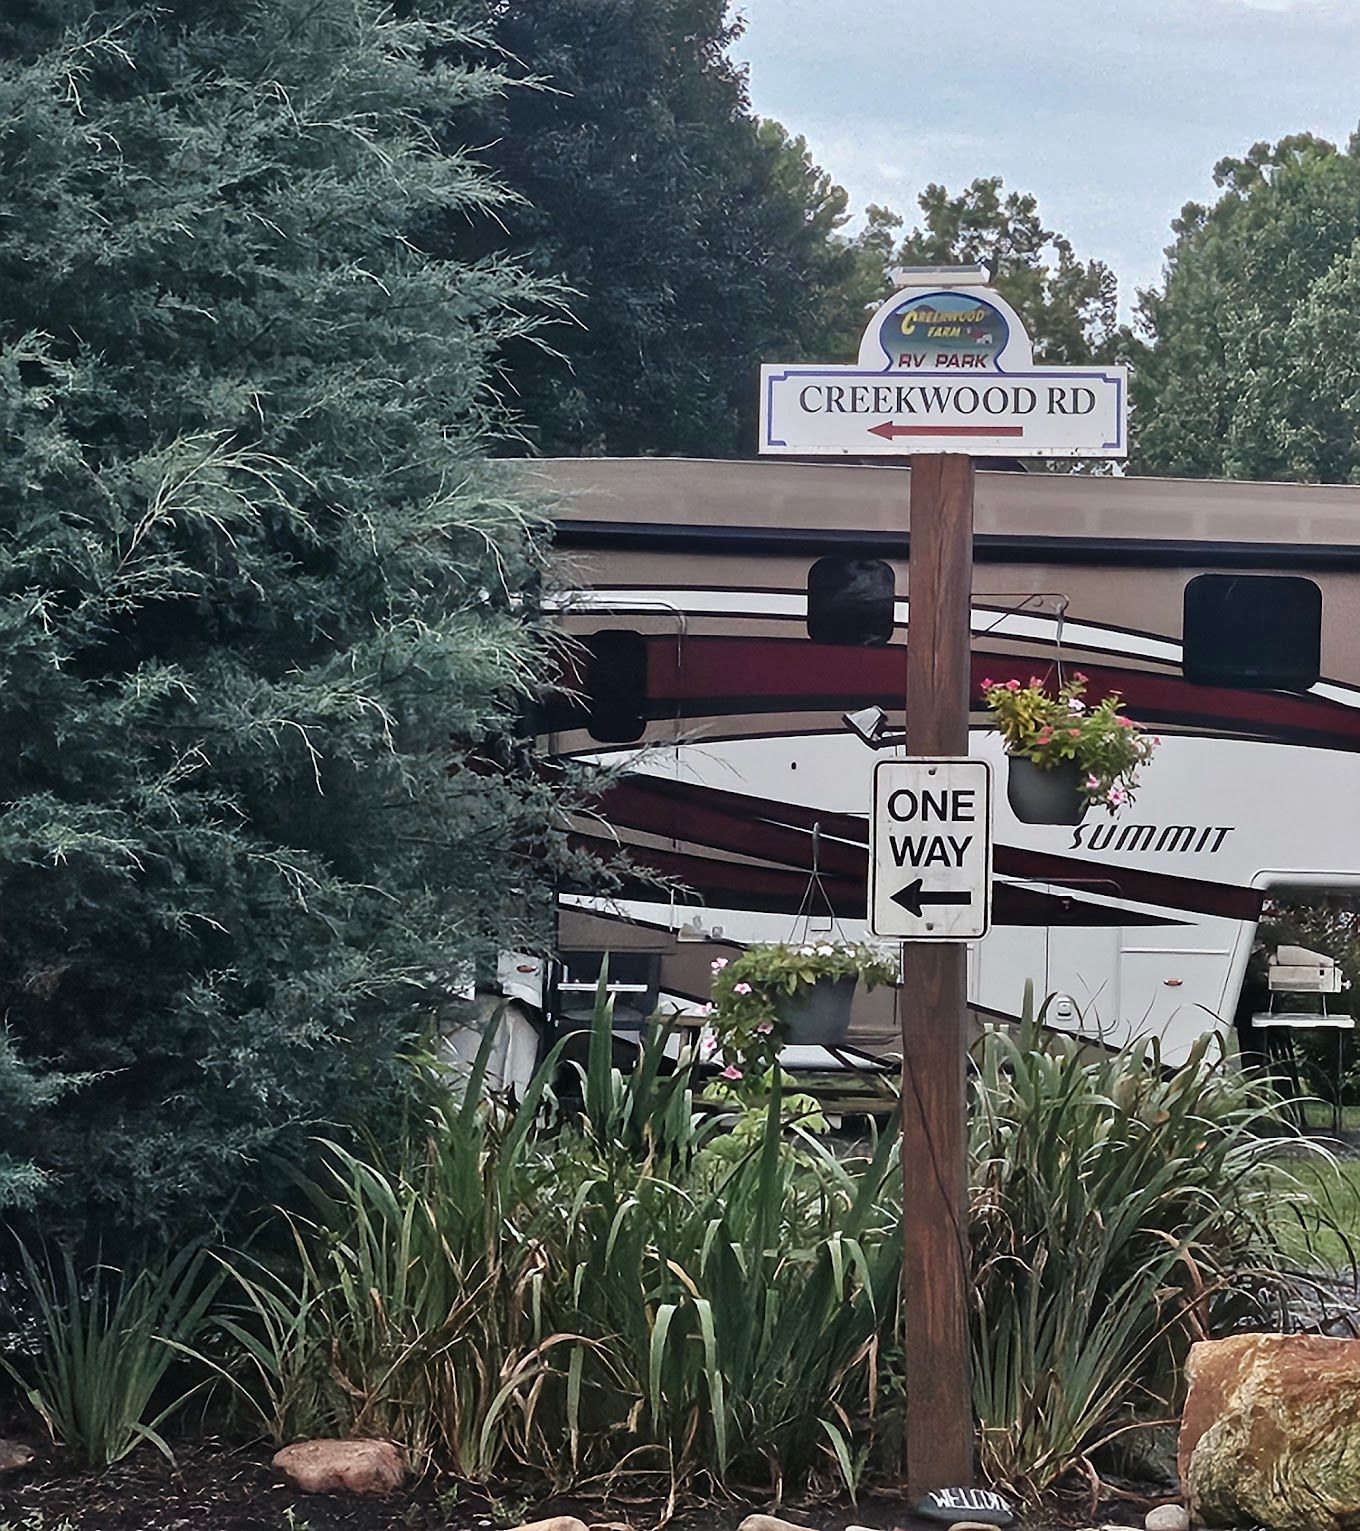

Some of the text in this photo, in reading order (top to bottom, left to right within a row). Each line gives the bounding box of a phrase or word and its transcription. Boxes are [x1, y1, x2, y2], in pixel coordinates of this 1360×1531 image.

[927, 326, 961, 337] FARM
[898, 353, 988, 368] RV PARK
[799, 385, 1096, 415] CREEKWOOD RD
[887, 789, 975, 822] ONE
[889, 835, 973, 868] WAY
[1068, 823, 1235, 853] SUMMIT
